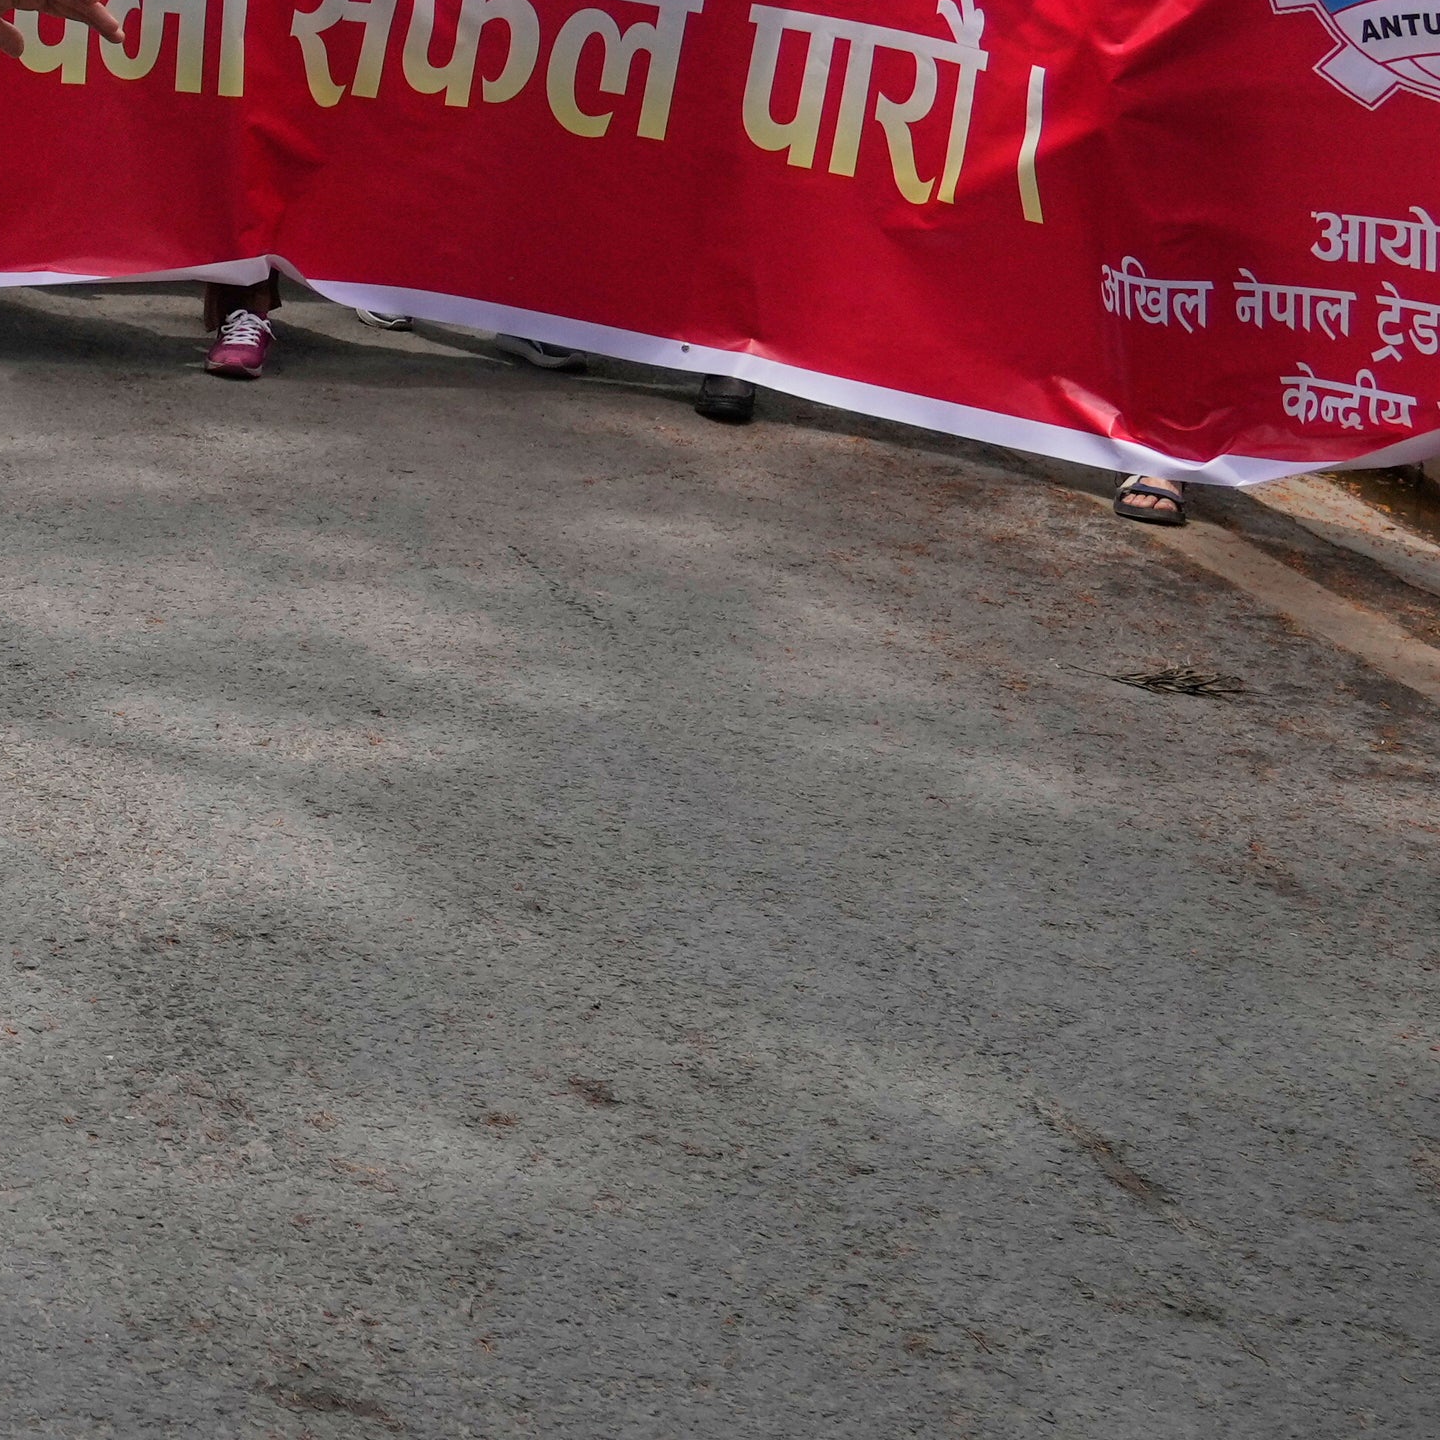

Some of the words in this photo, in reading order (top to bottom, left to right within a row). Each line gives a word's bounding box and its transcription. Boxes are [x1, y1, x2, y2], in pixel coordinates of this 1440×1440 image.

[1362, 13, 1440, 43] ANTU
[1310, 206, 1440, 272] आयो
[1099, 256, 1213, 334] अखिल
[1232, 268, 1358, 341] नेपाल
[1279, 361, 1418, 430] केन्द्रीय
